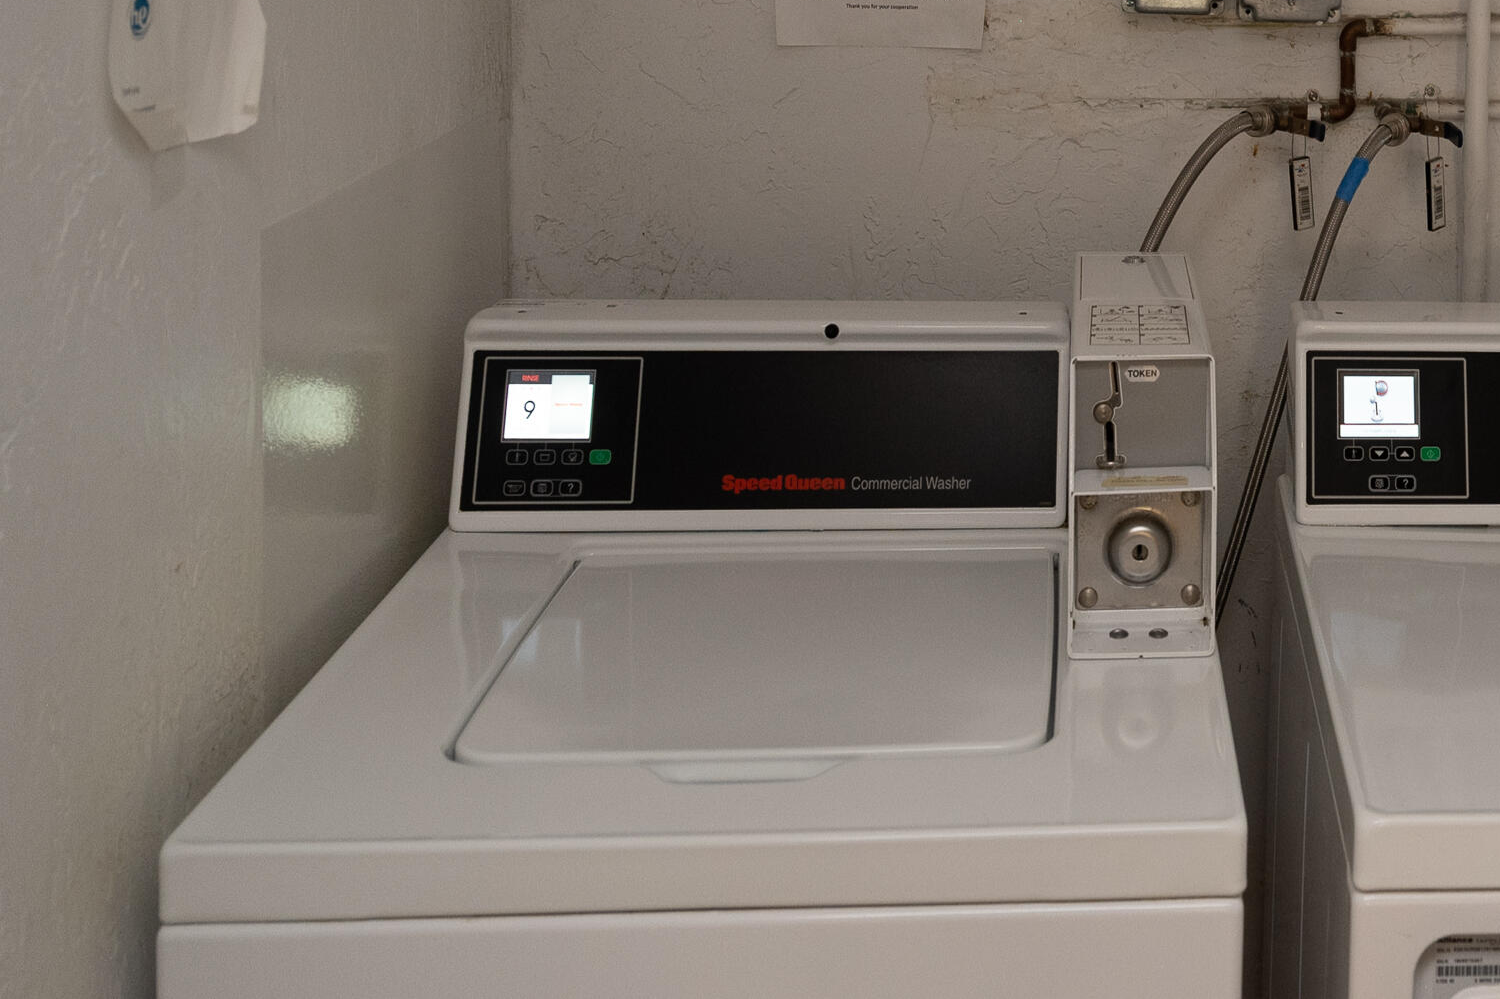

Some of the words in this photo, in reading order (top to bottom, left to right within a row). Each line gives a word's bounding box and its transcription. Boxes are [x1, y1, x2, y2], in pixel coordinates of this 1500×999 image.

[1128, 369, 1158, 377] TOKEN
[524, 400, 536, 419] 9
[722, 474, 783, 494] Speed
[785, 474, 846, 490] Queen
[851, 476, 922, 491] Commercial
[925, 476, 972, 490] Washer
